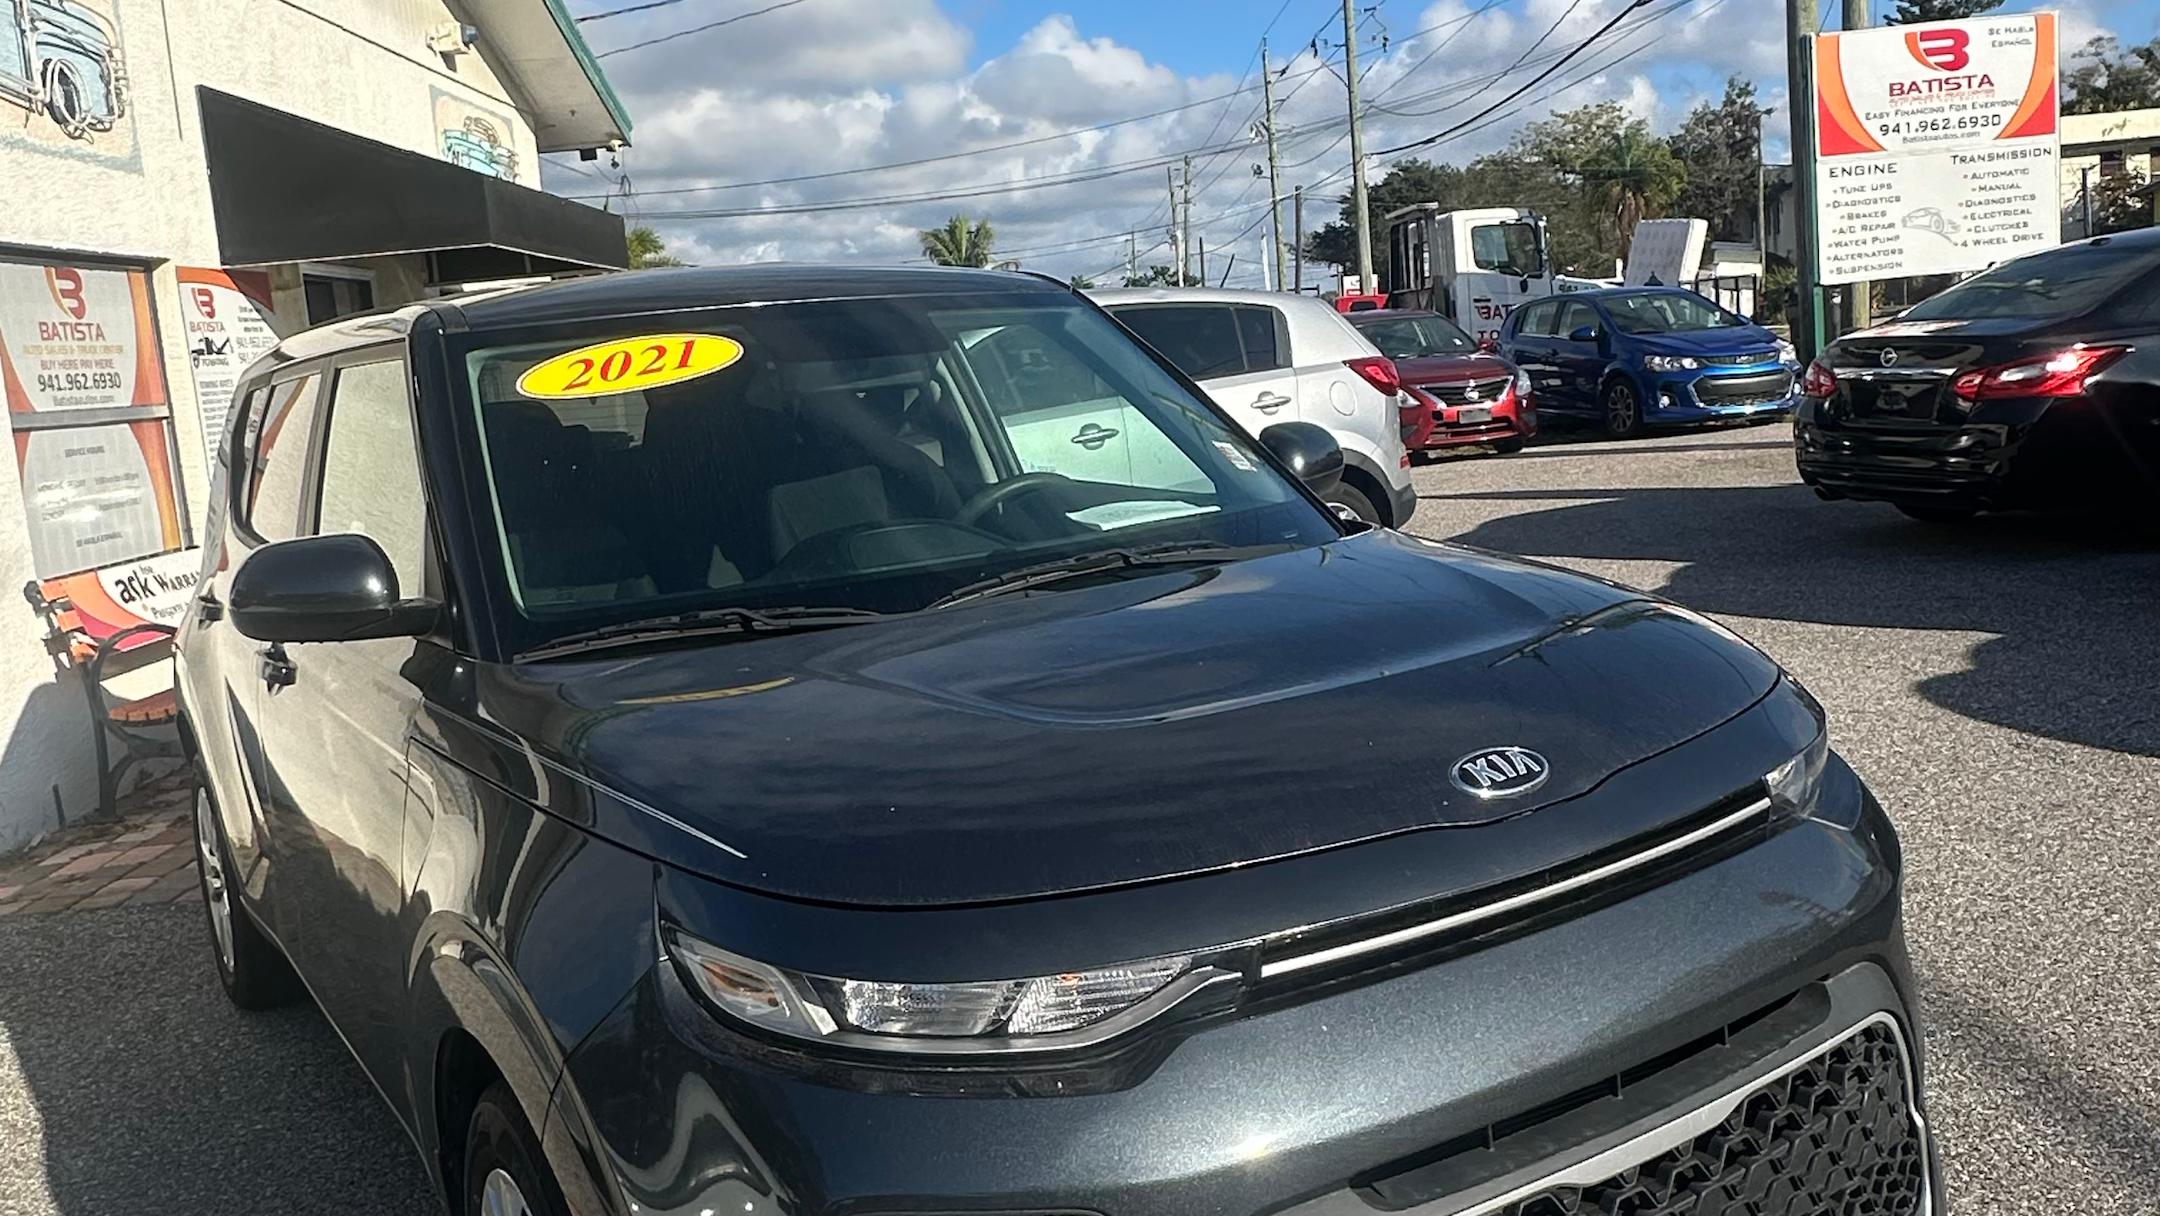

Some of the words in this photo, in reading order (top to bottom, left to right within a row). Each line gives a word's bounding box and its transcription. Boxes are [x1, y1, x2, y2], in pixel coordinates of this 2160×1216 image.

[1889, 73, 1995, 97] BATISTA
[1865, 112, 1891, 121] EASY
[1895, 106, 1945, 117] FINANCING
[1950, 104, 1967, 113] FOR
[1972, 98, 2019, 109] EVERYONE
[1879, 114, 2001, 137] 941.962.6930
[1950, 147, 2052, 165] TRANSMISSION
[1829, 162, 1898, 178] ENGINE
[1970, 168, 2030, 180] AUTOMATIC
[1839, 185, 1867, 194] TUNE
[1871, 183, 1892, 191] UPS
[1978, 182, 2022, 192] MANUAL
[1832, 195, 1901, 209] DIAGNOSTICS
[1965, 193, 2036, 208] DIAGNOSTICS
[1846, 210, 1887, 220] BRAKES
[1970, 208, 2032, 221] ELECTRICAL
[1838, 225, 1856, 234] A/C
[1860, 222, 1896, 232] REPAIR
[1974, 221, 2029, 233] CLUTCHES
[1833, 239, 1867, 248] WATER
[1871, 234, 1900, 244] PUMP
[1961, 240, 1968, 248] 4
[1972, 237, 2008, 246] WHEEL
[2012, 233, 2044, 242] DRIVE
[1832, 248, 1904, 262] ALTERNATORS
[1835, 261, 1903, 275] SUSPENSION
[39, 322, 106, 341] BATISTA
[189, 321, 226, 333] BATISTA
[40, 360, 55, 370] BUY
[57, 359, 78, 370] HERE
[94, 359, 115, 369] HERE
[560, 339, 697, 392] 2021
[38, 371, 122, 392] 941.962.6930
[115, 570, 156, 604] ark
[1462, 751, 1542, 787] KIA
